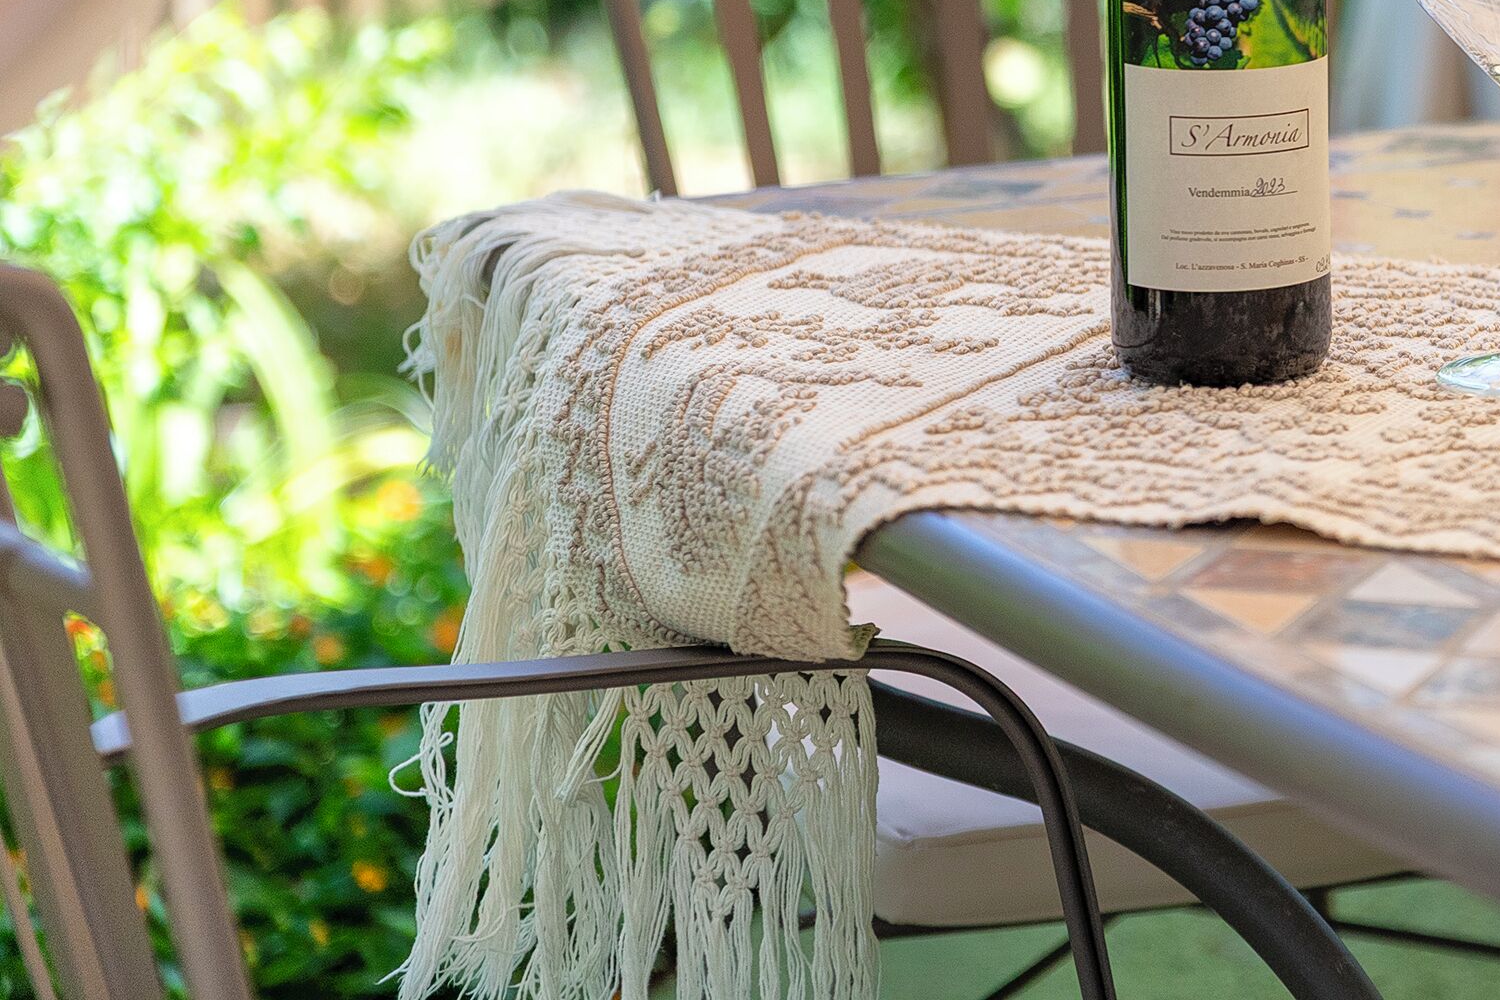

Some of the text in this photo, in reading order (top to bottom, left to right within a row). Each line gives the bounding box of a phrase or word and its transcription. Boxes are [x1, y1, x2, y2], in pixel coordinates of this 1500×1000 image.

[1180, 123, 1303, 151] S'Armonia
[1188, 186, 1250, 198] Vendemmia
[1249, 177, 1286, 198] 2023
